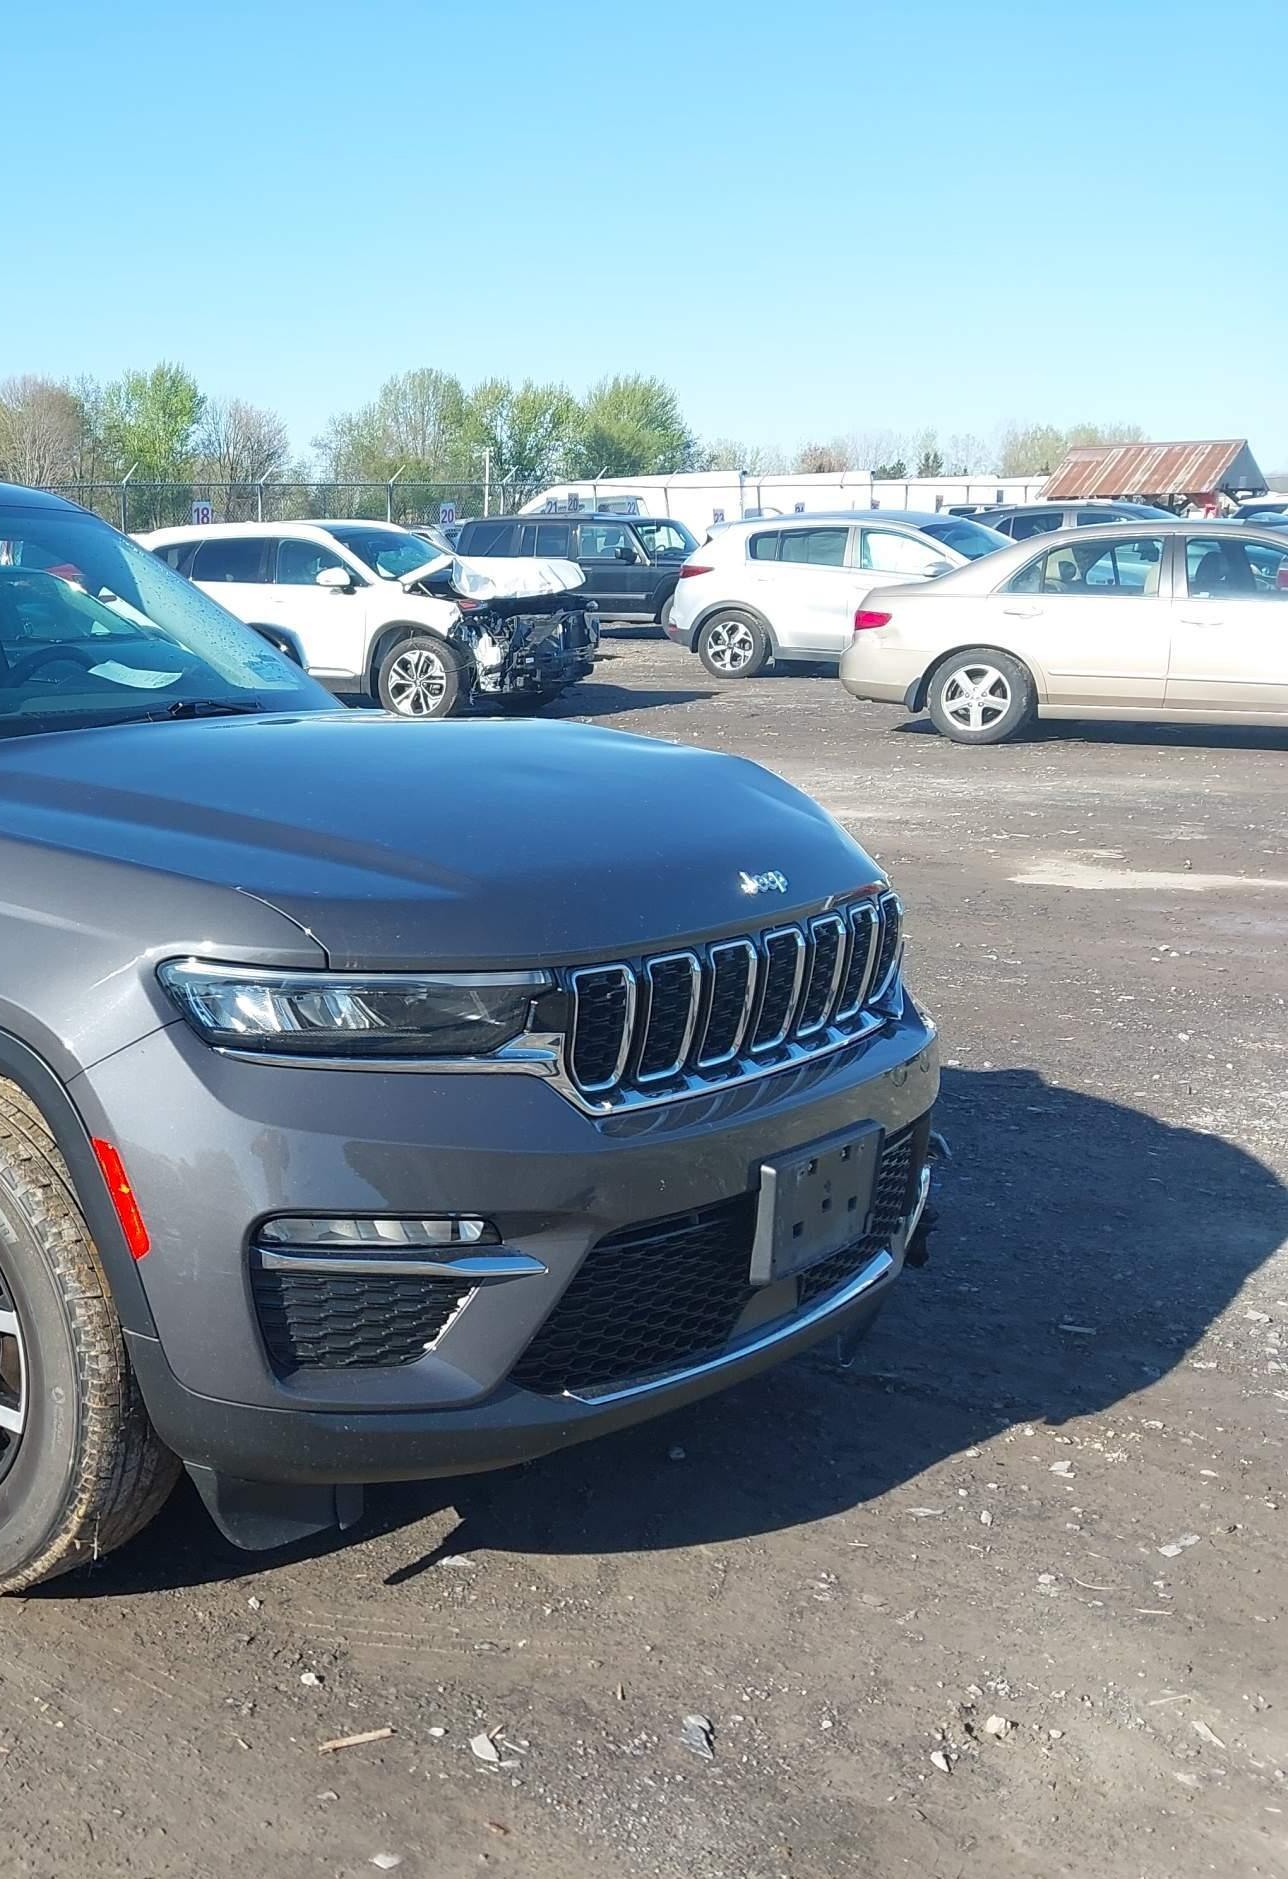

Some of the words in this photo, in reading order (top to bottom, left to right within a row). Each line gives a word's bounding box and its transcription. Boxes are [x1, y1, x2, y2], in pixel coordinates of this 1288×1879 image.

[568, 499, 579, 511] 20
[194, 507, 210, 525] 18
[441, 509, 454, 524] 20
